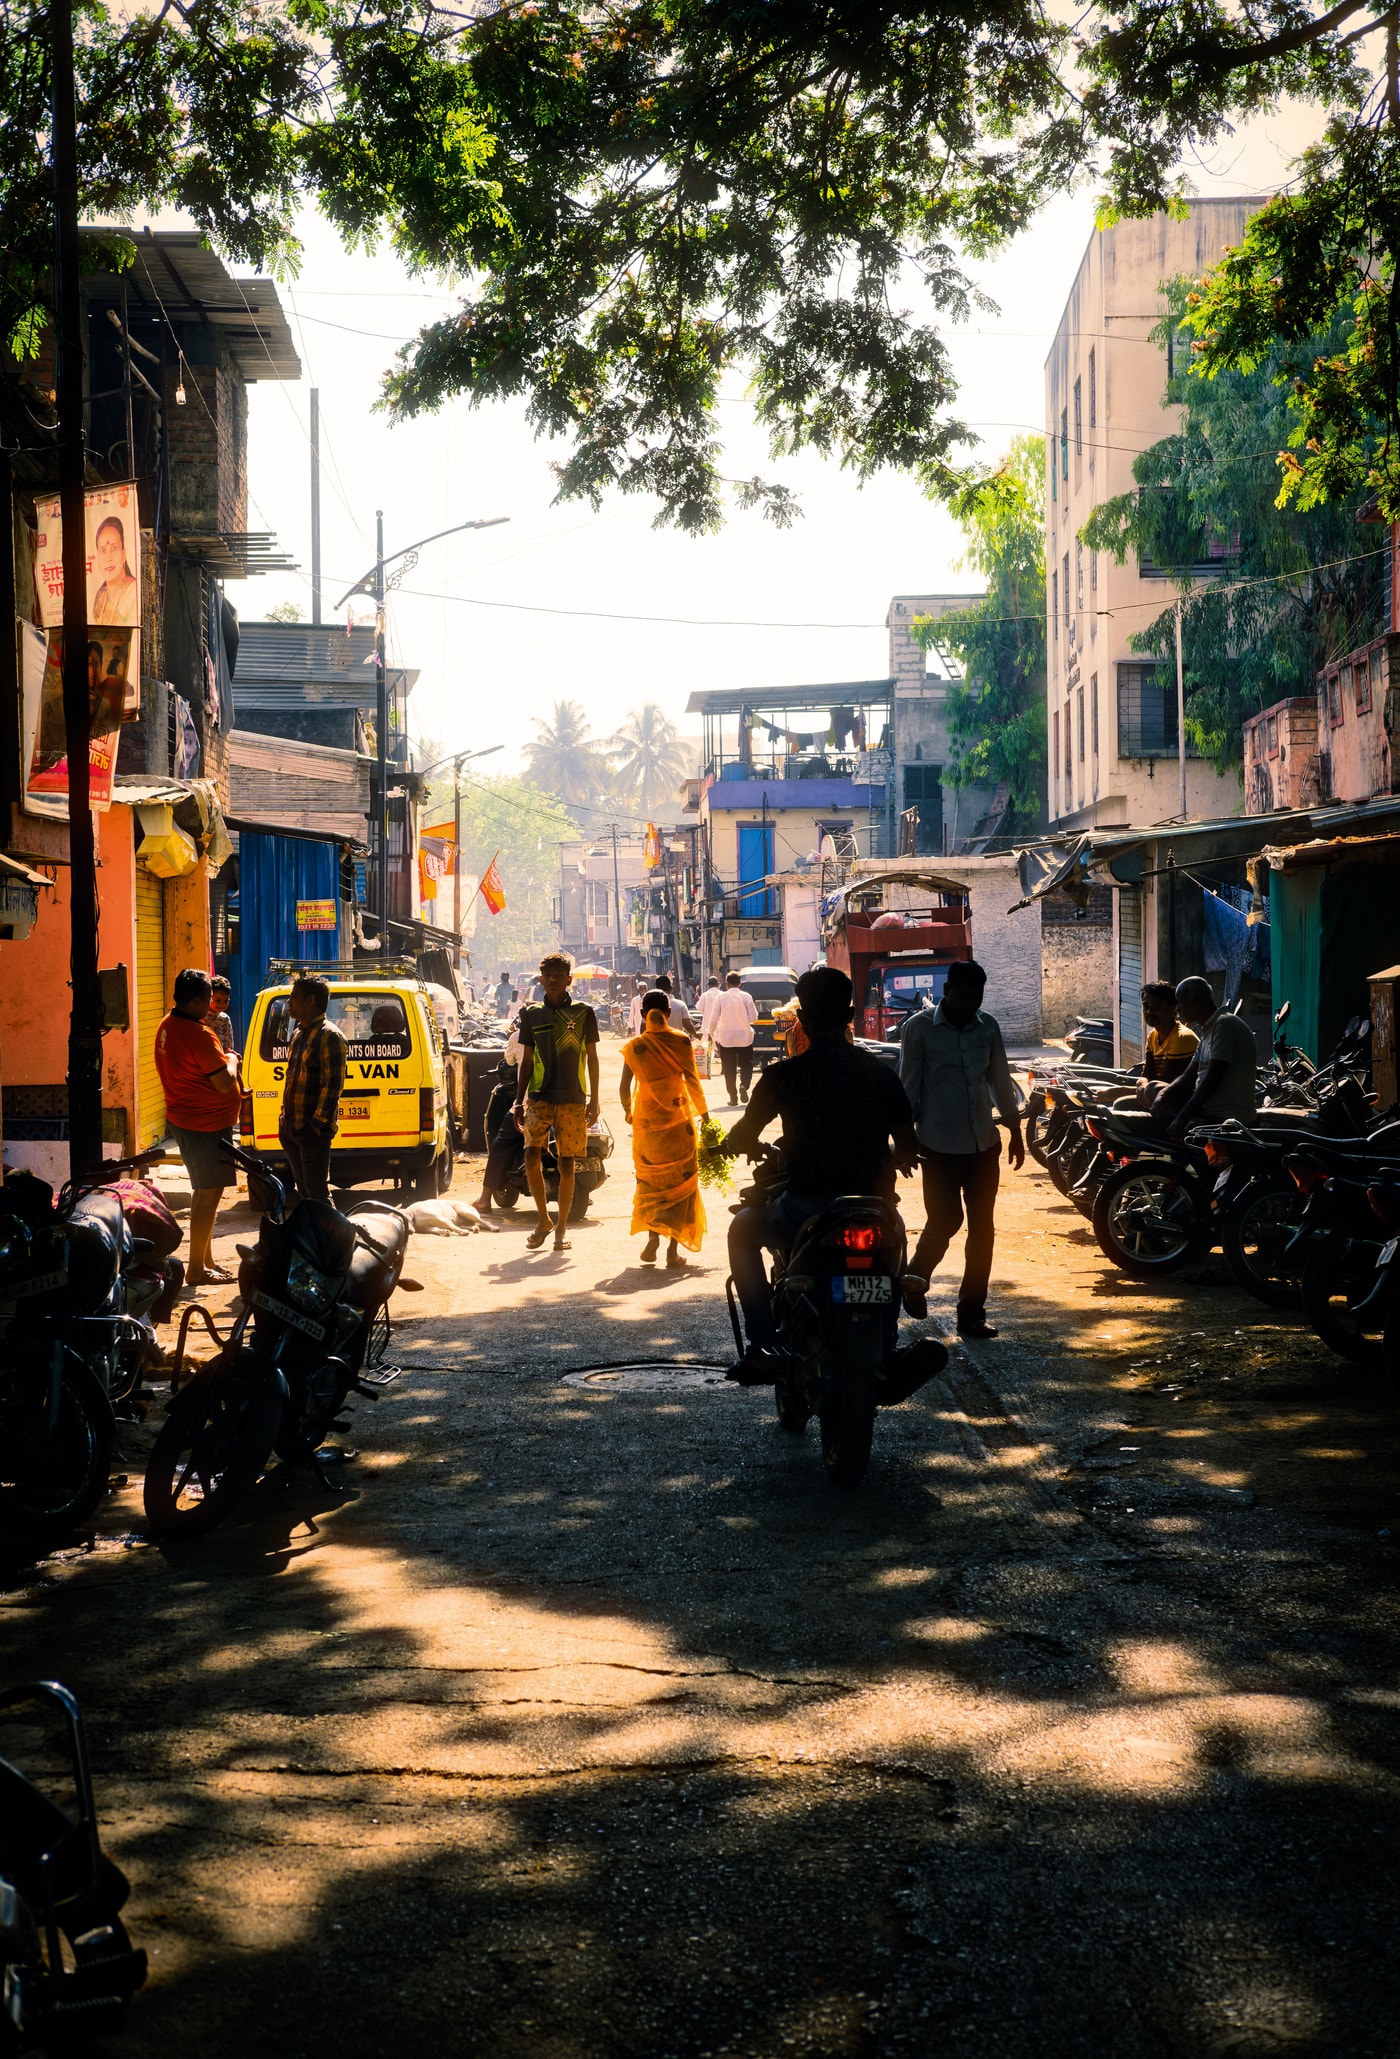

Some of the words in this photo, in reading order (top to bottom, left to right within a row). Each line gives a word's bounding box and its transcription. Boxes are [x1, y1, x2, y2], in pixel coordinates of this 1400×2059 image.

[272, 1046, 289, 1060] DRIV
[364, 1045, 375, 1057] ON
[377, 1044, 402, 1057] BOARD
[359, 1064, 399, 1079] VAN
[348, 1106, 368, 1115] 1334
[848, 1277, 883, 1290] MH12
